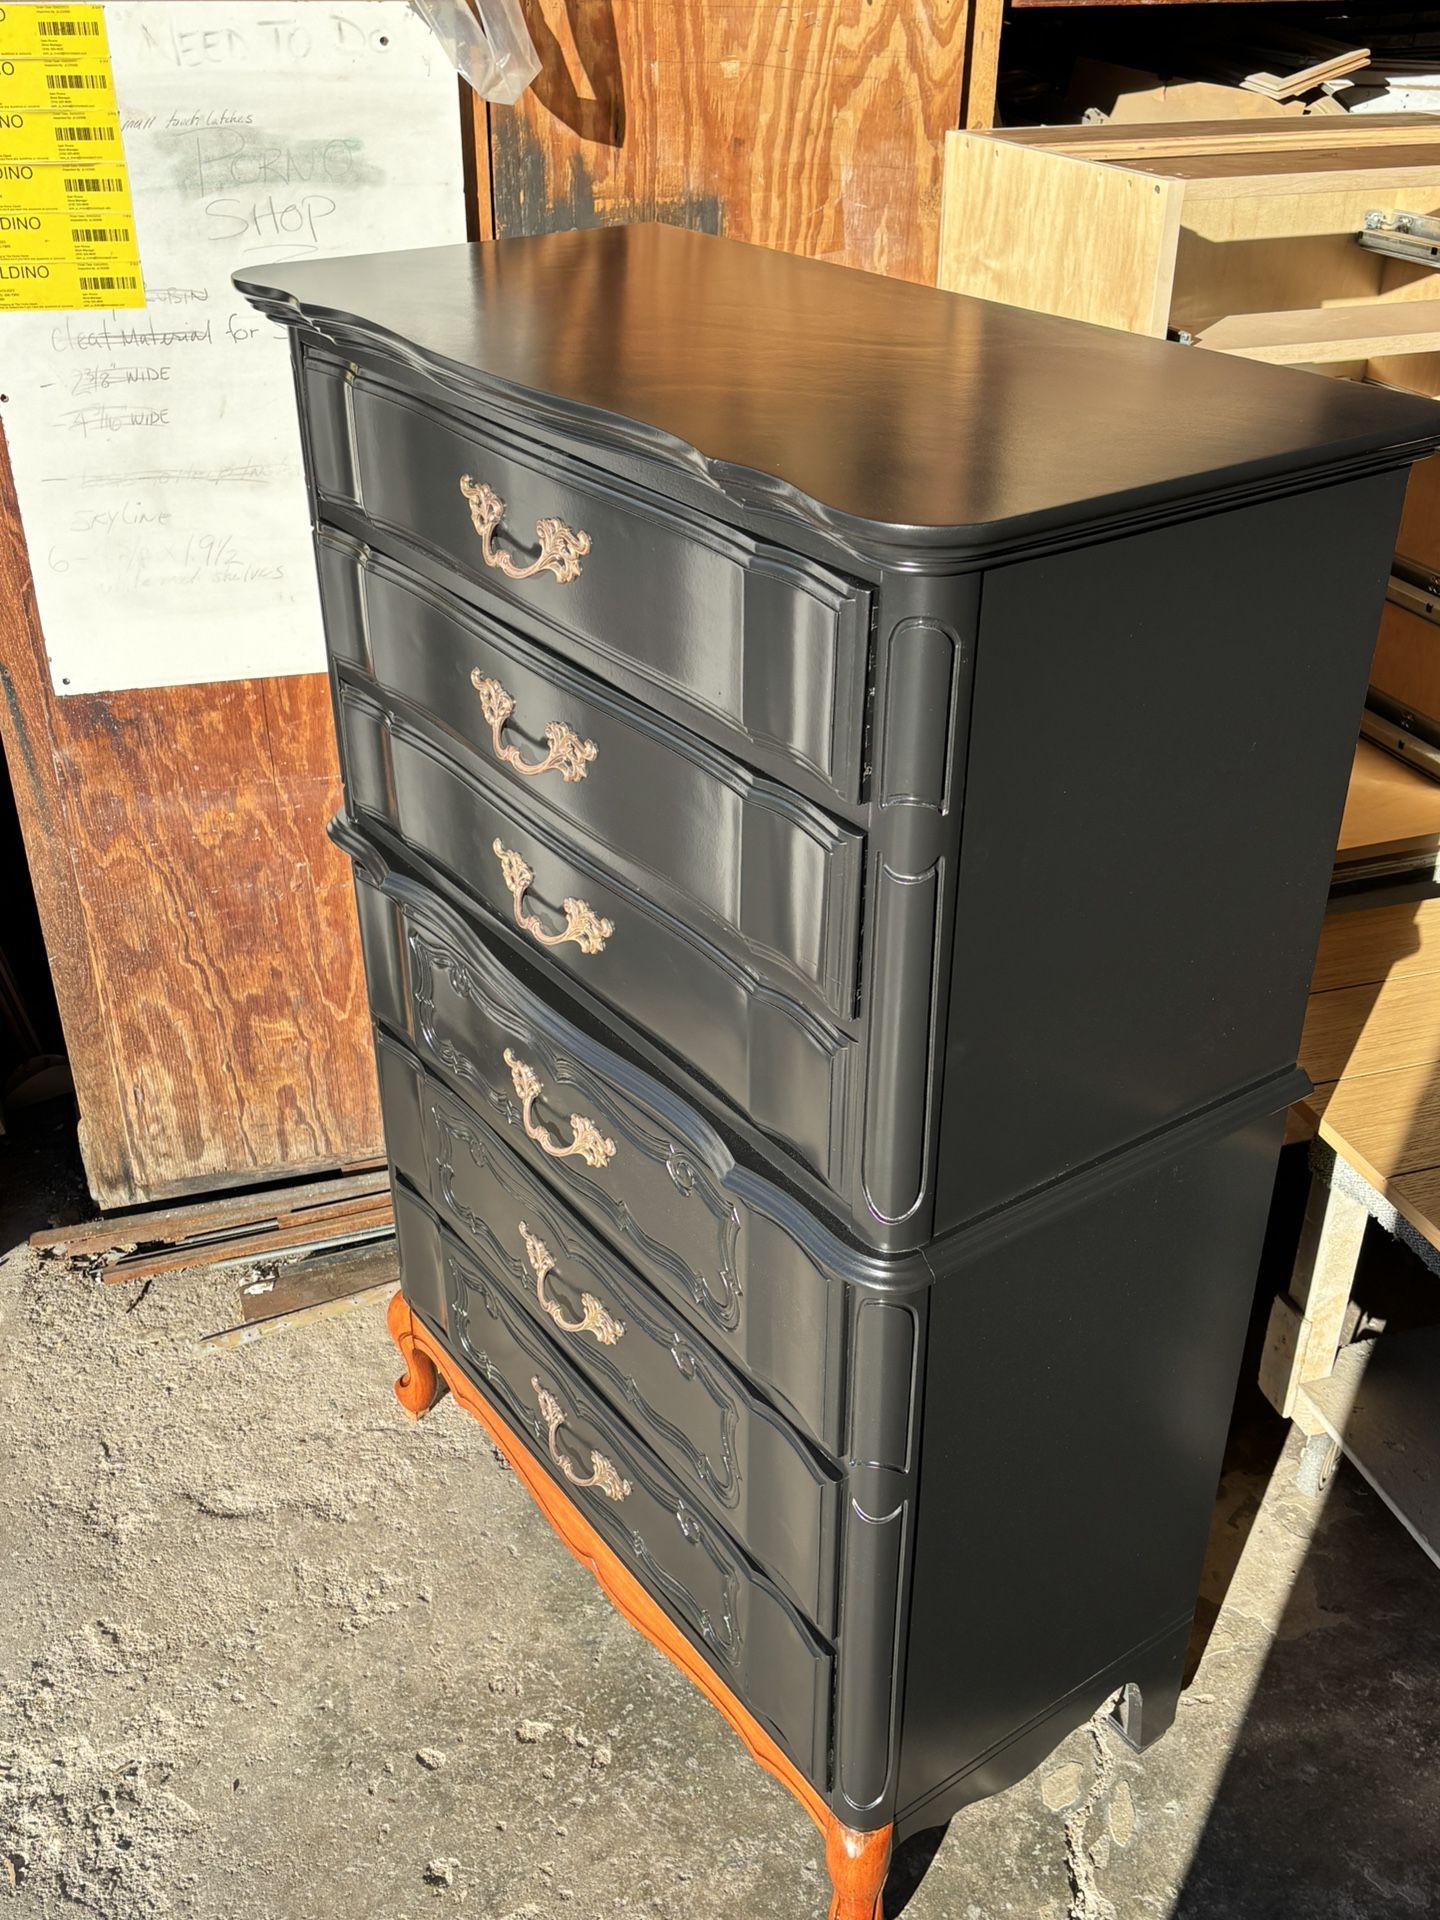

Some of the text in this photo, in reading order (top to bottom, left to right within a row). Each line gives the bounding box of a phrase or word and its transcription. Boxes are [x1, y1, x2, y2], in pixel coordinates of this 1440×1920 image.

[257, 18, 312, 60] TO
[330, 14, 392, 55] DO
[204, 194, 337, 243] SHOP
[225, 313, 260, 345] for
